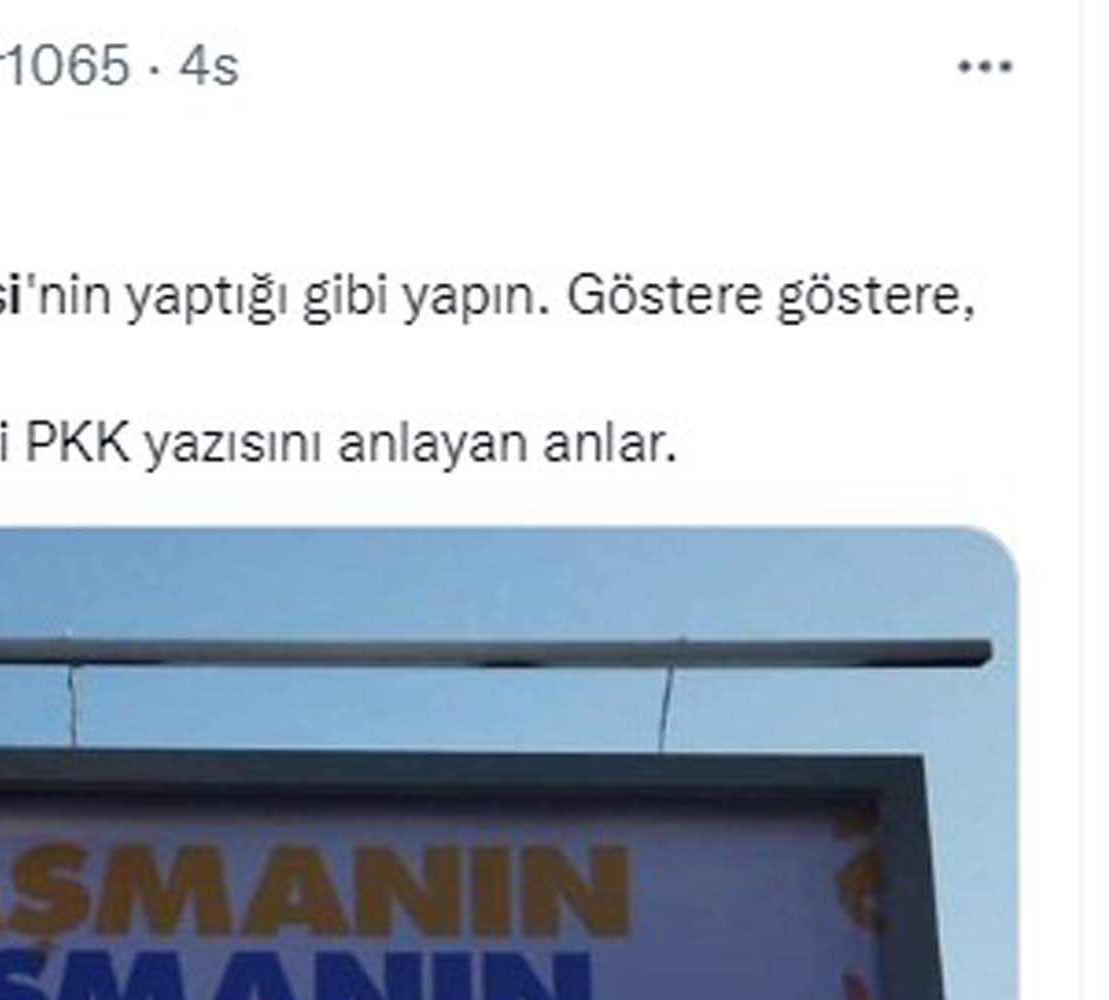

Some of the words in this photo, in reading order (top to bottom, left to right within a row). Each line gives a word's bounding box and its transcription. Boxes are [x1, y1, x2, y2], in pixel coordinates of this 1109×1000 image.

[180, 44, 238, 86] 4s
[125, 272, 286, 326] yaptığı
[304, 273, 387, 326] gibi
[402, 283, 548, 326] yapın.
[568, 272, 762, 315] Göstere
[778, 273, 974, 326] göstere,
[28, 420, 130, 462] PKK
[143, 421, 320, 473] yazısını
[339, 421, 526, 473] anlayan
[544, 421, 675, 462] anlar.
